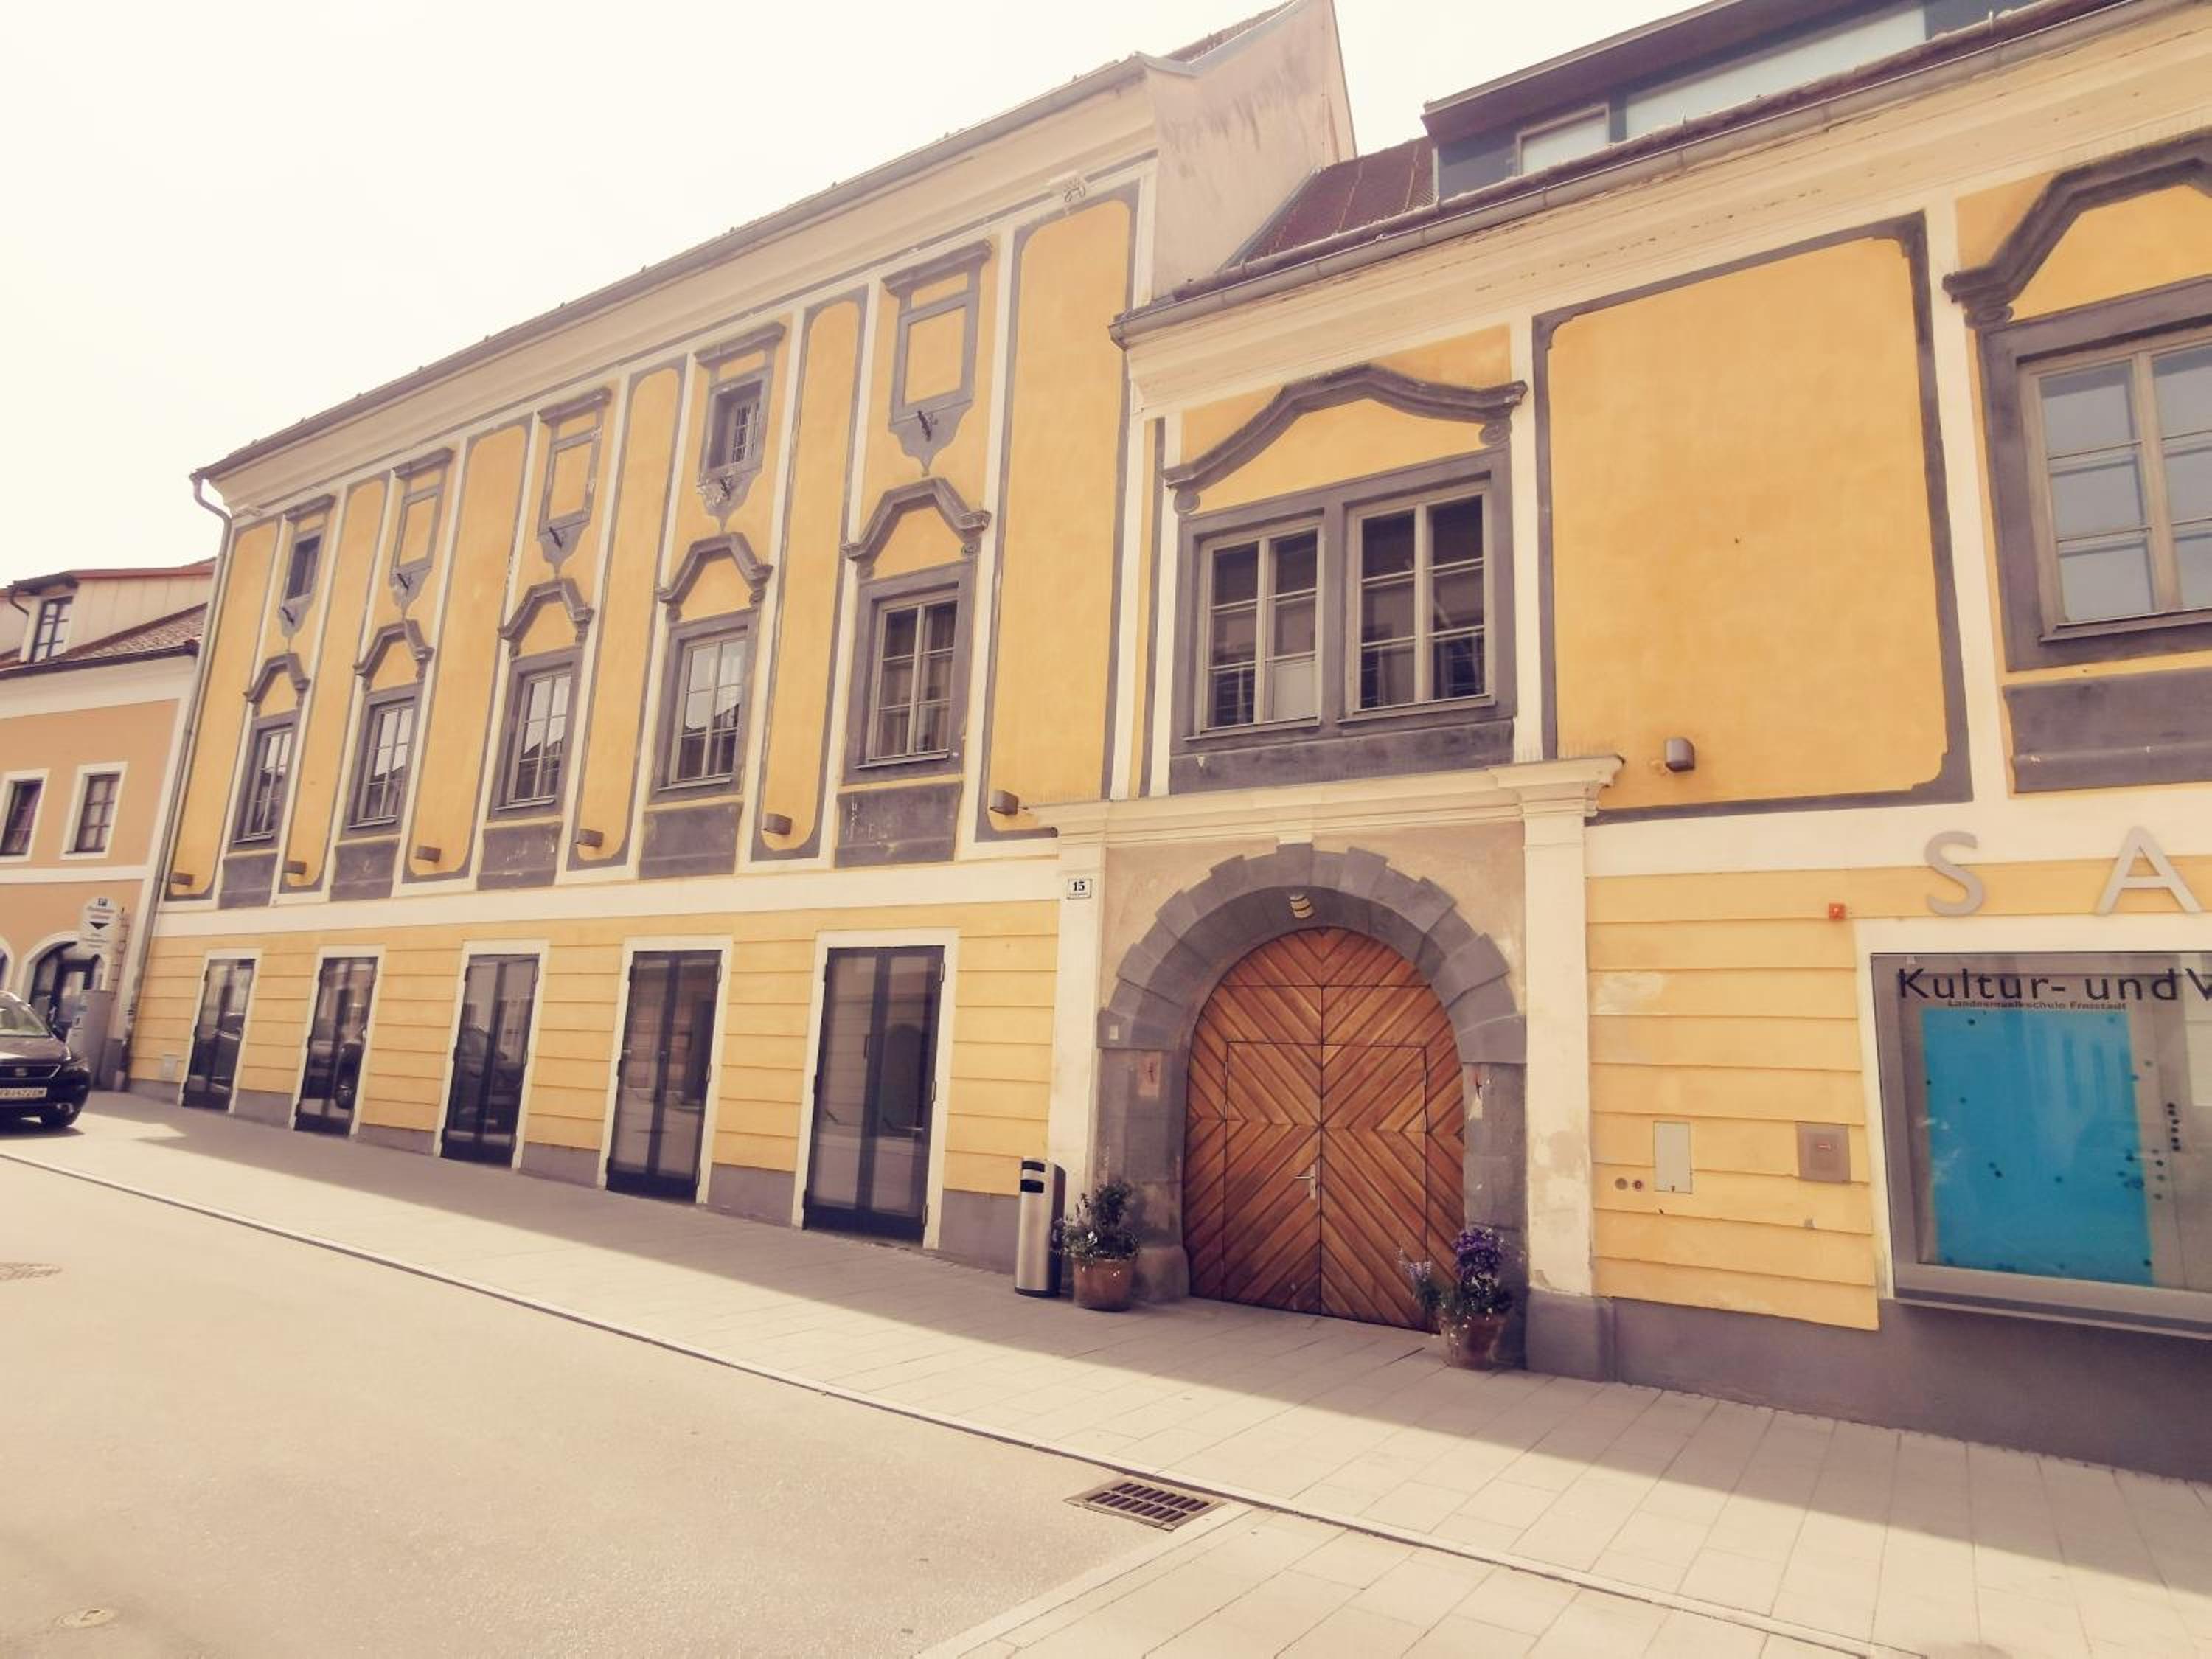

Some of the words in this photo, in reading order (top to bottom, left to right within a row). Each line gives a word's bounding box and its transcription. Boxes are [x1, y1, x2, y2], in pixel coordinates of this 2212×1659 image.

[1073, 880, 1085, 891] 15
[1898, 967, 2065, 1000] Kultur-
[2084, 967, 2177, 1001] und
